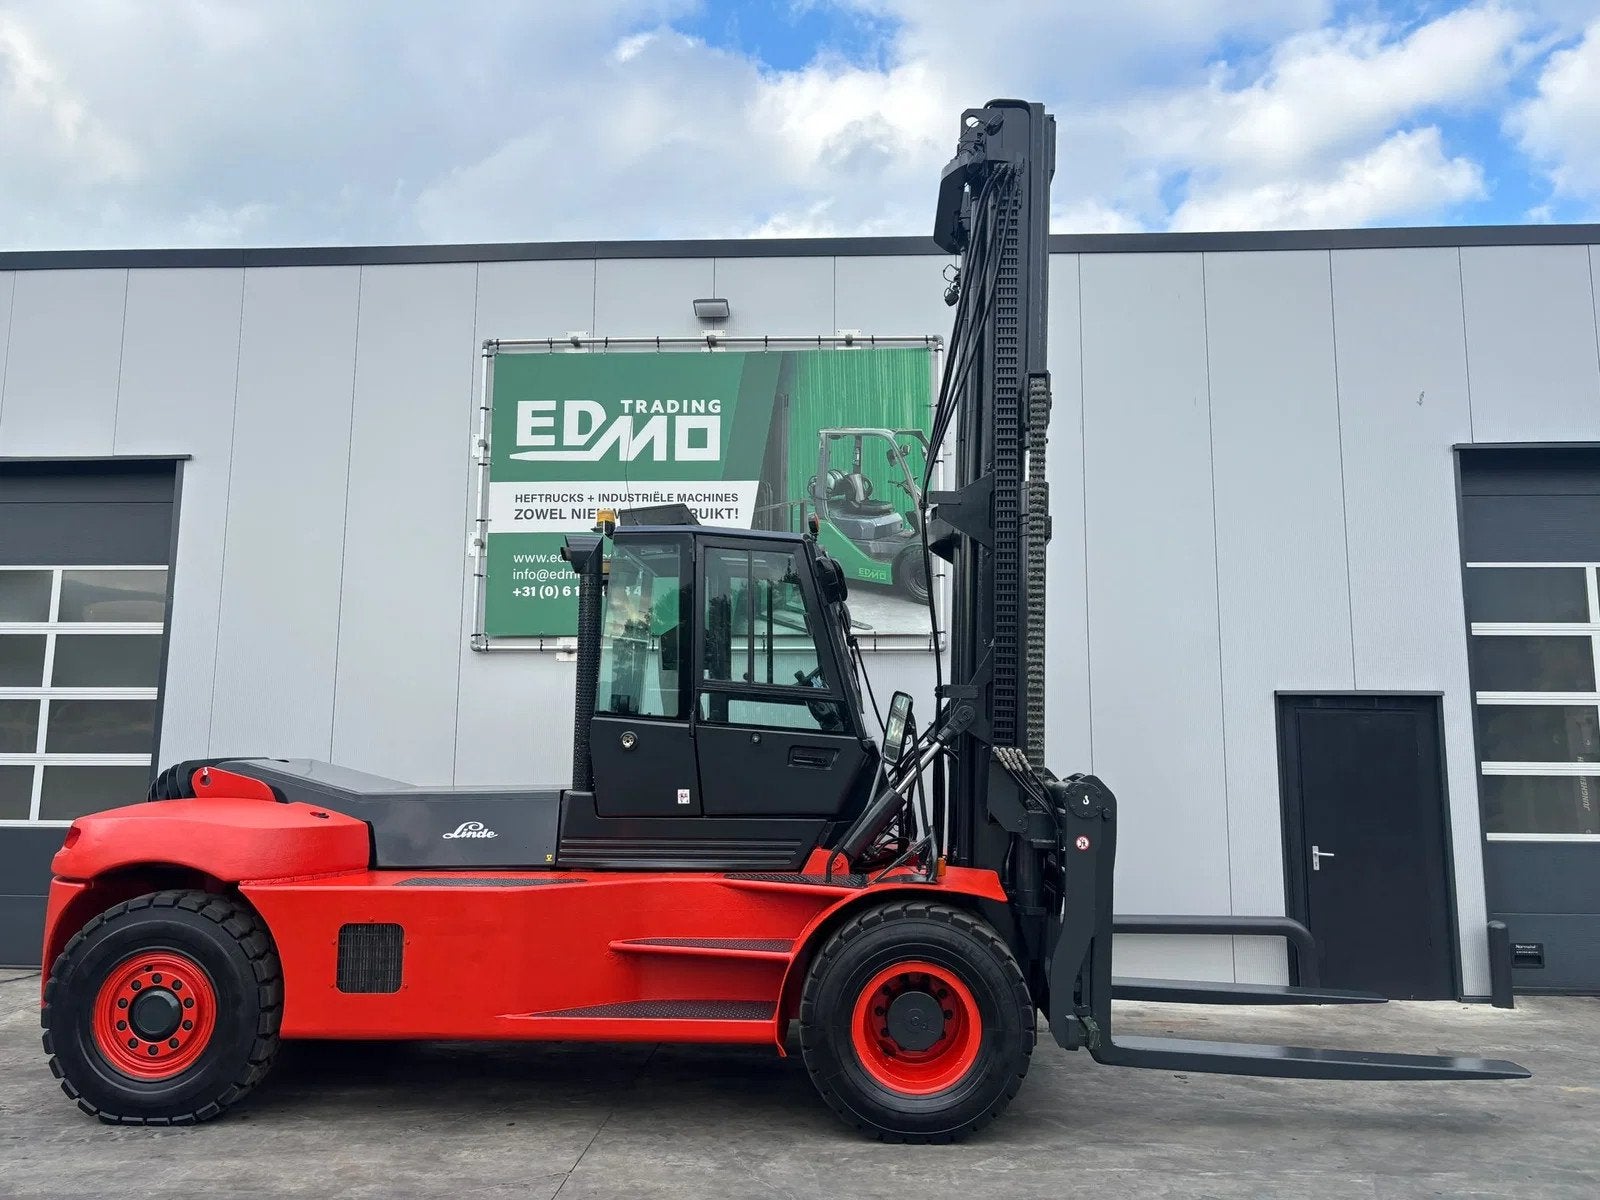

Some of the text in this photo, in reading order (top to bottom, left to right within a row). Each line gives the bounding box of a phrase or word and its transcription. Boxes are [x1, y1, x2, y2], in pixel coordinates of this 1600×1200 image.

[620, 399, 721, 414] TRADING
[510, 400, 721, 461] EDMO
[515, 491, 739, 503] HEFTRUCKS + INDUSTRIËLE MACHINES
[514, 508, 567, 520] ZOWEL
[690, 508, 739, 519] RUIKT!
[512, 568, 581, 582] info@edm
[512, 586, 536, 597] +31
[539, 585, 559, 599] (0)
[562, 586, 571, 596] 6
[442, 821, 499, 839] Linde
